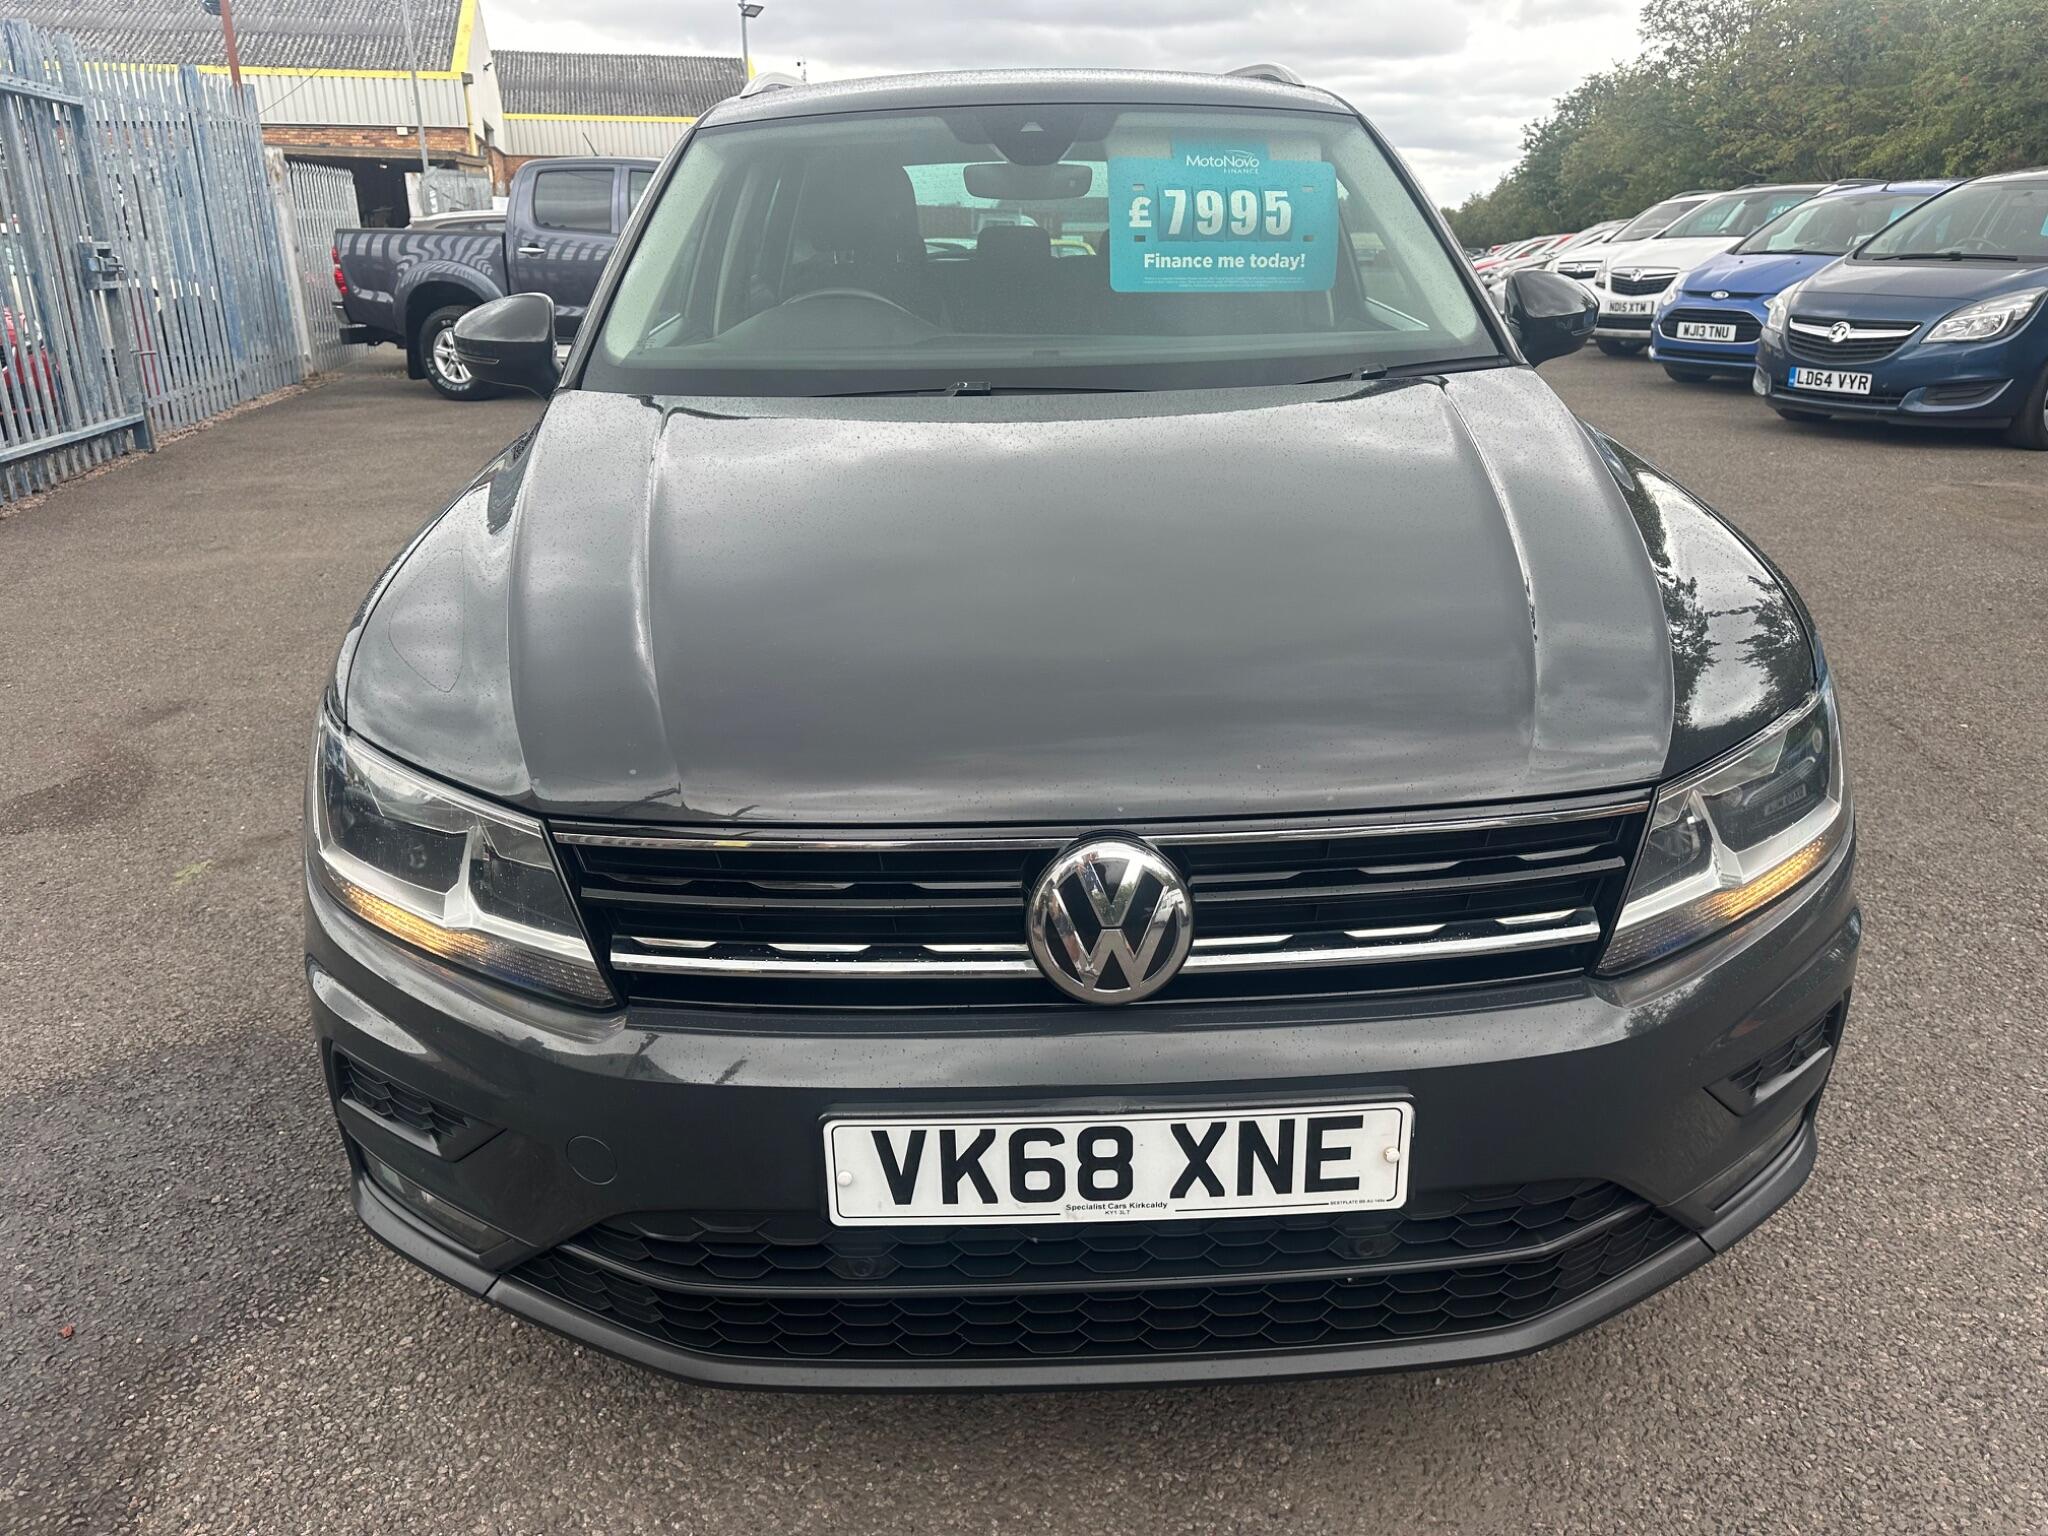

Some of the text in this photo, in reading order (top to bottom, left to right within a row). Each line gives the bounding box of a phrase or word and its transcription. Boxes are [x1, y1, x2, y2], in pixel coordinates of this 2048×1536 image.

[1186, 154, 1260, 168] MotoNovo
[1143, 253, 1306, 271] Finance me today!
[1683, 324, 1730, 338] WJ13 TNU
[1797, 370, 1869, 390] LD64 VYR
[871, 1115, 1364, 1205] VK68 XNE
[1065, 1203, 1106, 1211] Specialist
